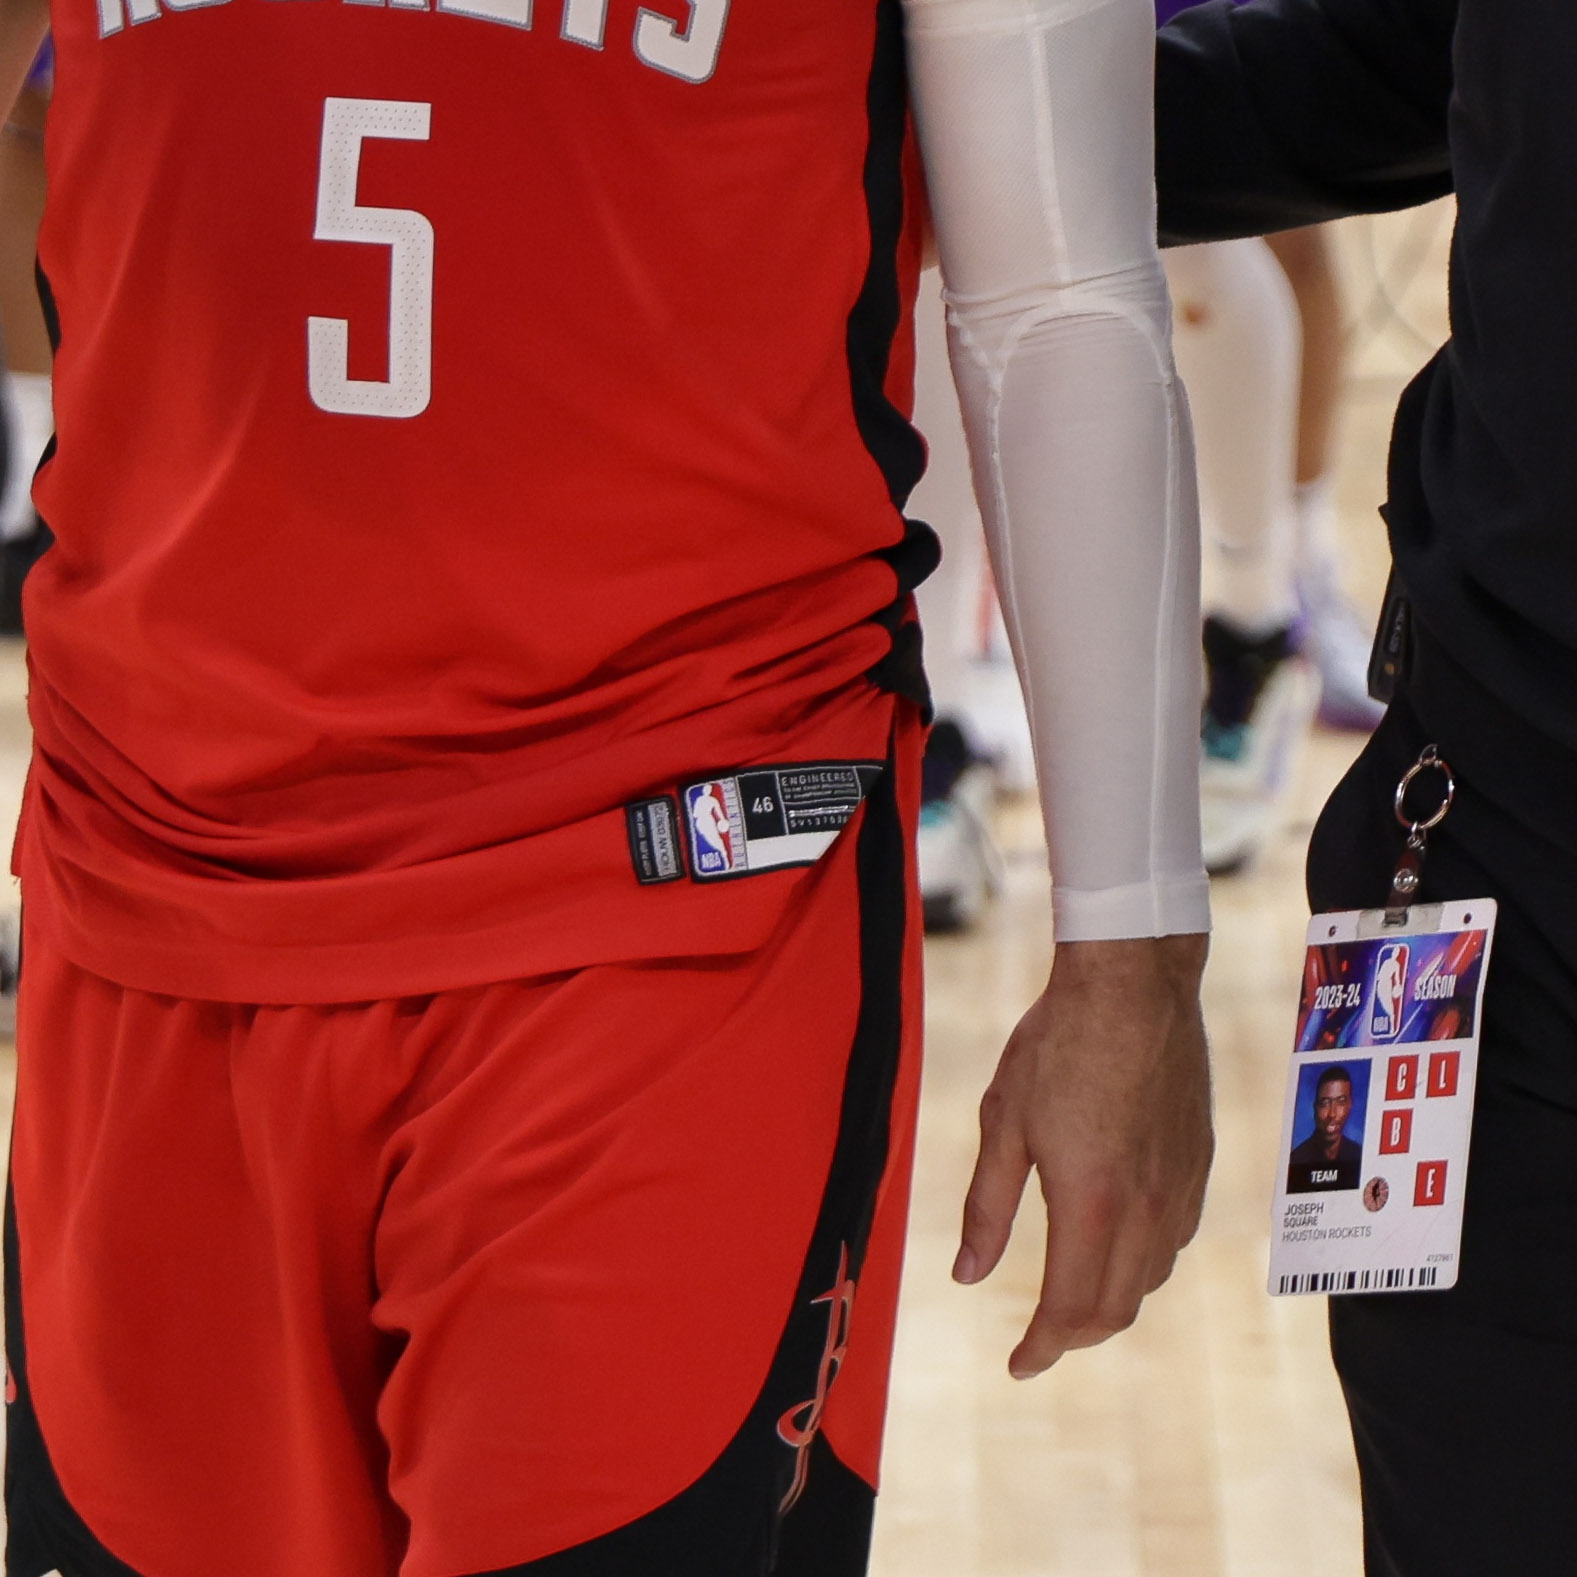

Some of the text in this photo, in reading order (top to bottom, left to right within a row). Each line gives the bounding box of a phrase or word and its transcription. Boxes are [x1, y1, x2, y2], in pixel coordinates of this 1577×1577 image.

[306, 96, 435, 419] 5
[751, 796, 774, 814] 46
[1315, 973, 1458, 1009] 2023-24 SEASON
[1396, 1062, 1407, 1093] C
[1390, 1116, 1402, 1147] B
[1311, 1169, 1338, 1183] TEAM
[1425, 1168, 1436, 1198] E
[1285, 1201, 1325, 1216] JOSEPH
[1281, 1224, 1373, 1242] HOUSTON ROCKETS
[1283, 1215, 1319, 1228] SQUARE
